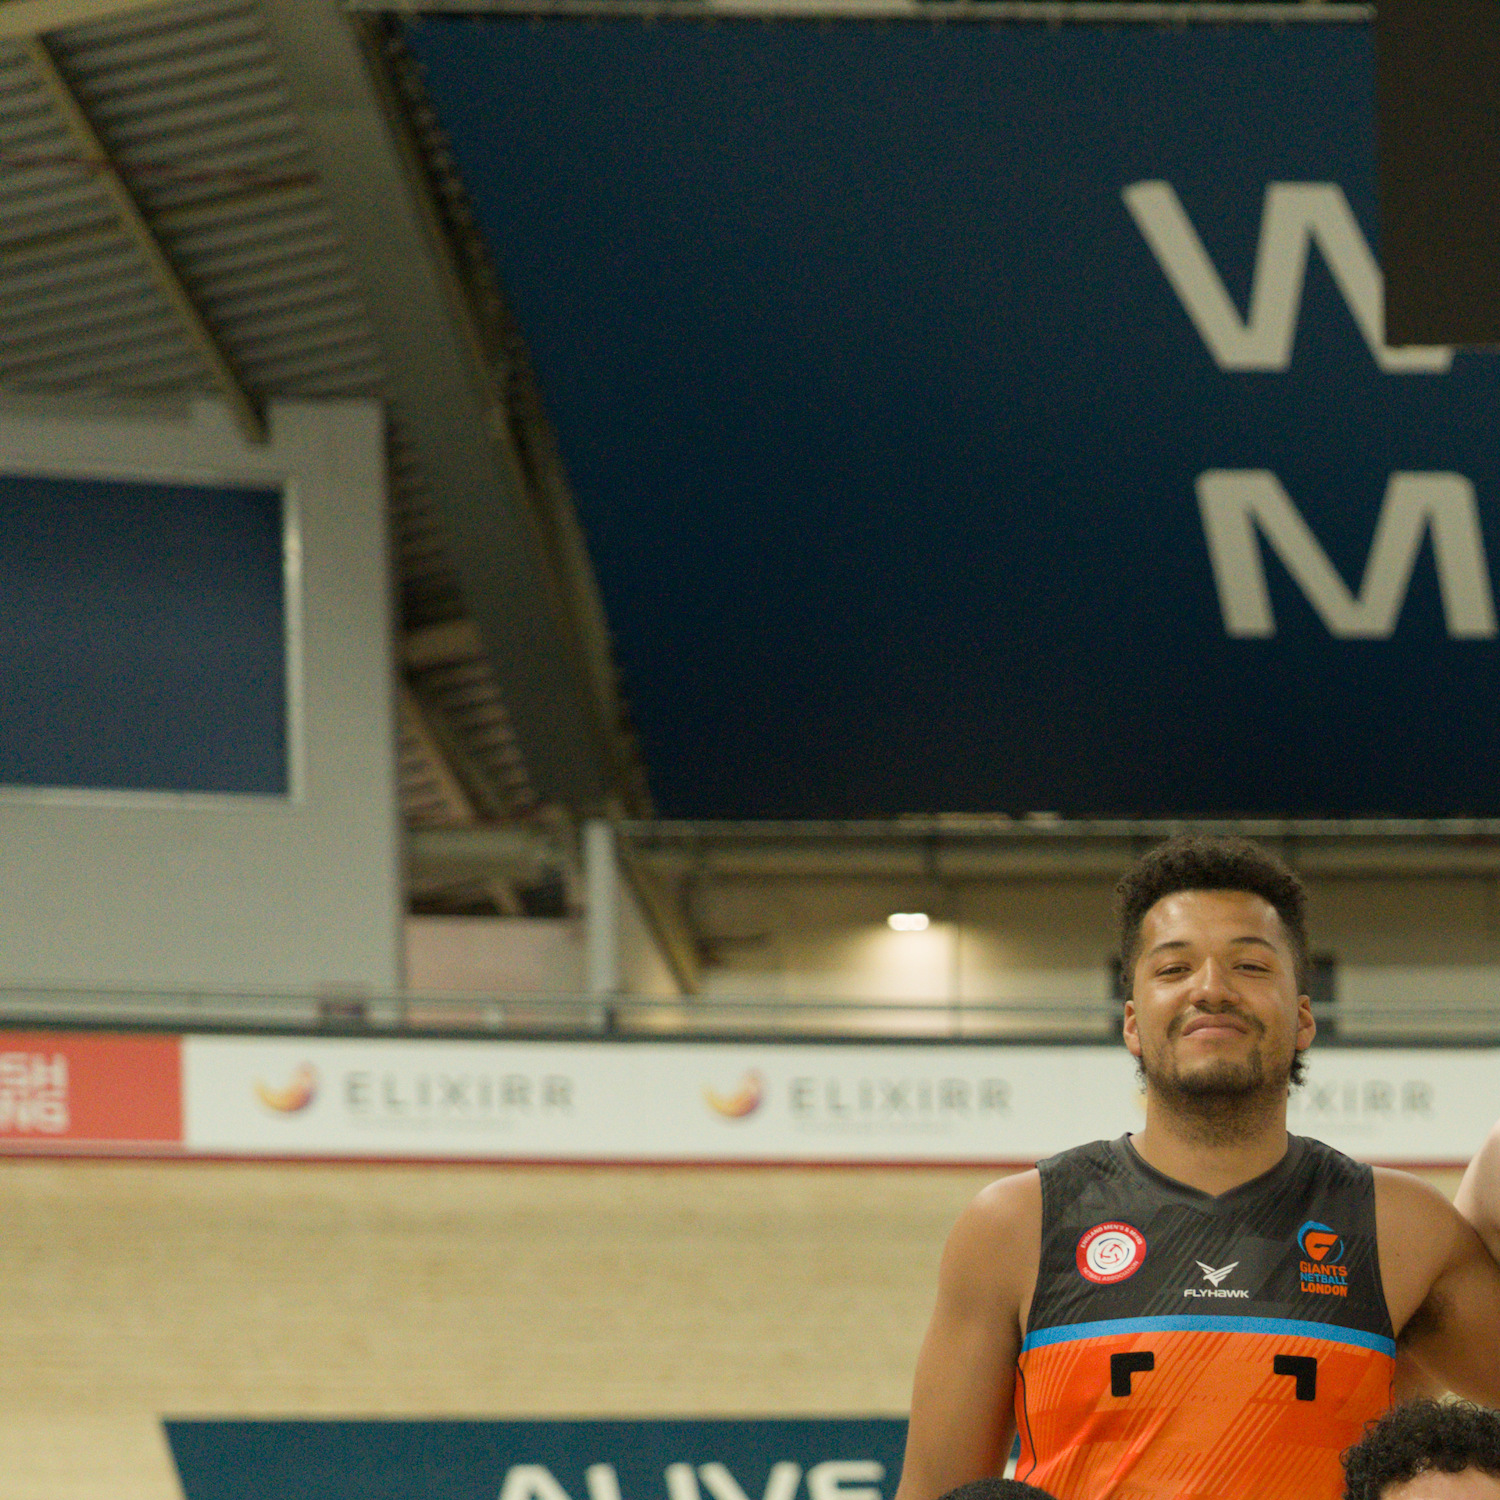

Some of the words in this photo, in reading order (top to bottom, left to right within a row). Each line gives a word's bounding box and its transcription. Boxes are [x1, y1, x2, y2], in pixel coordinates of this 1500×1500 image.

[343, 1070, 575, 1114] ELIXIRR
[788, 1075, 1013, 1115] ELIXIRR
[1300, 1261, 1347, 1277] GIANTS
[1300, 1272, 1347, 1285] NETBALL
[1301, 1282, 1347, 1297] LONDON
